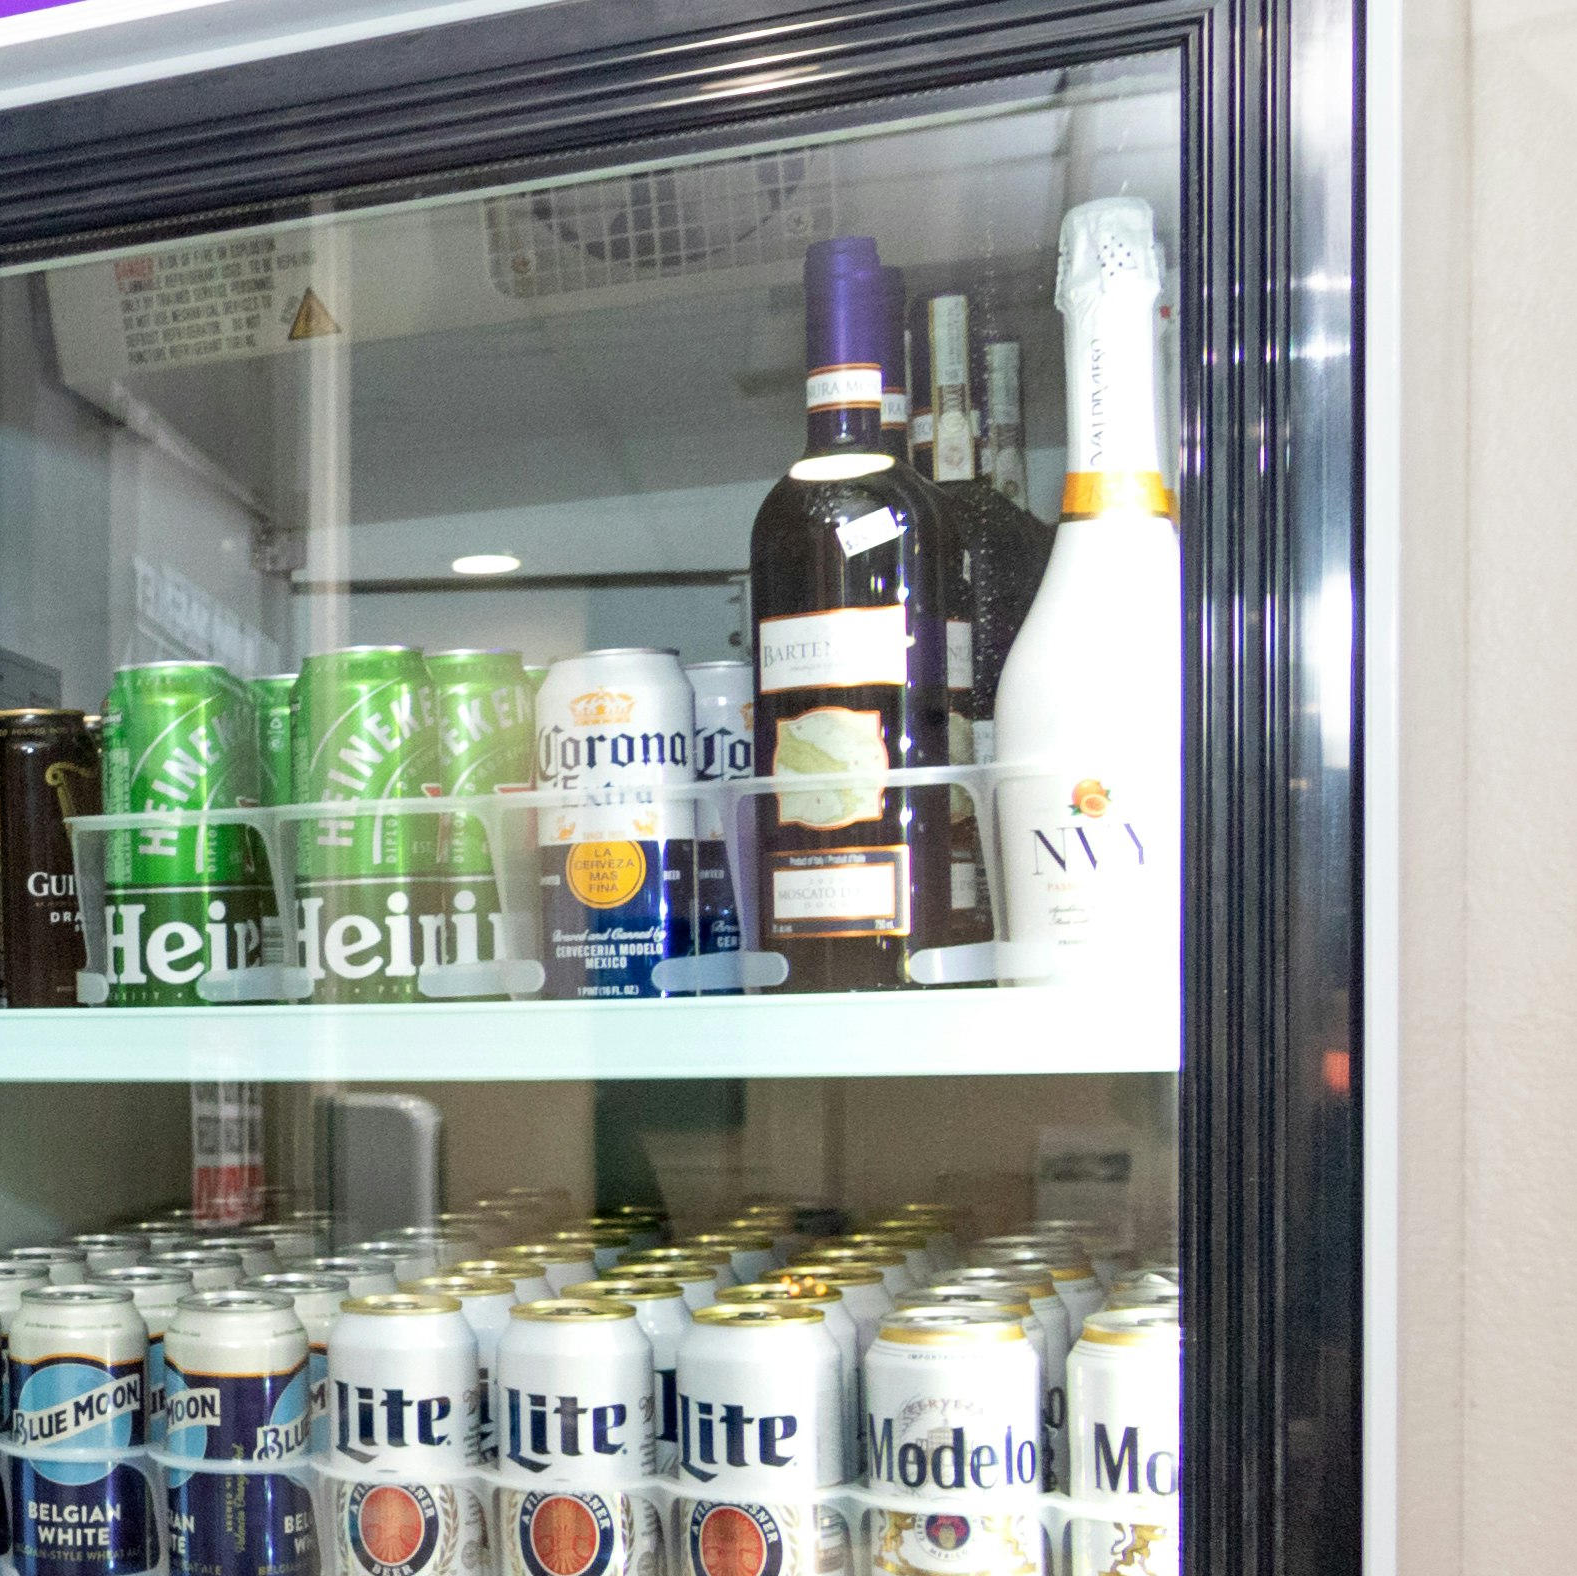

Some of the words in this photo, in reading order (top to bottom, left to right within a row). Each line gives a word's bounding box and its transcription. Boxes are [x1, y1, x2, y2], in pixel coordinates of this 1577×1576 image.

[538, 724, 688, 788] Corona
[594, 848, 612, 857] LA
[575, 859, 635, 871] CERVEZA
[589, 883, 619, 894] FINA
[556, 943, 617, 958] CERVECERIA
[620, 941, 664, 956] MODELO
[585, 955, 628, 969] MEXICO
[14, 1408, 69, 1447] BLUE
[74, 1377, 139, 1427] MOON
[334, 1379, 452, 1464] Lite
[504, 1386, 628, 1473] Lite
[678, 1392, 798, 1483] Lite
[867, 1412, 1037, 1491] Modelo
[28, 1501, 122, 1523] BELGIAN
[38, 1526, 110, 1548] WHITE
